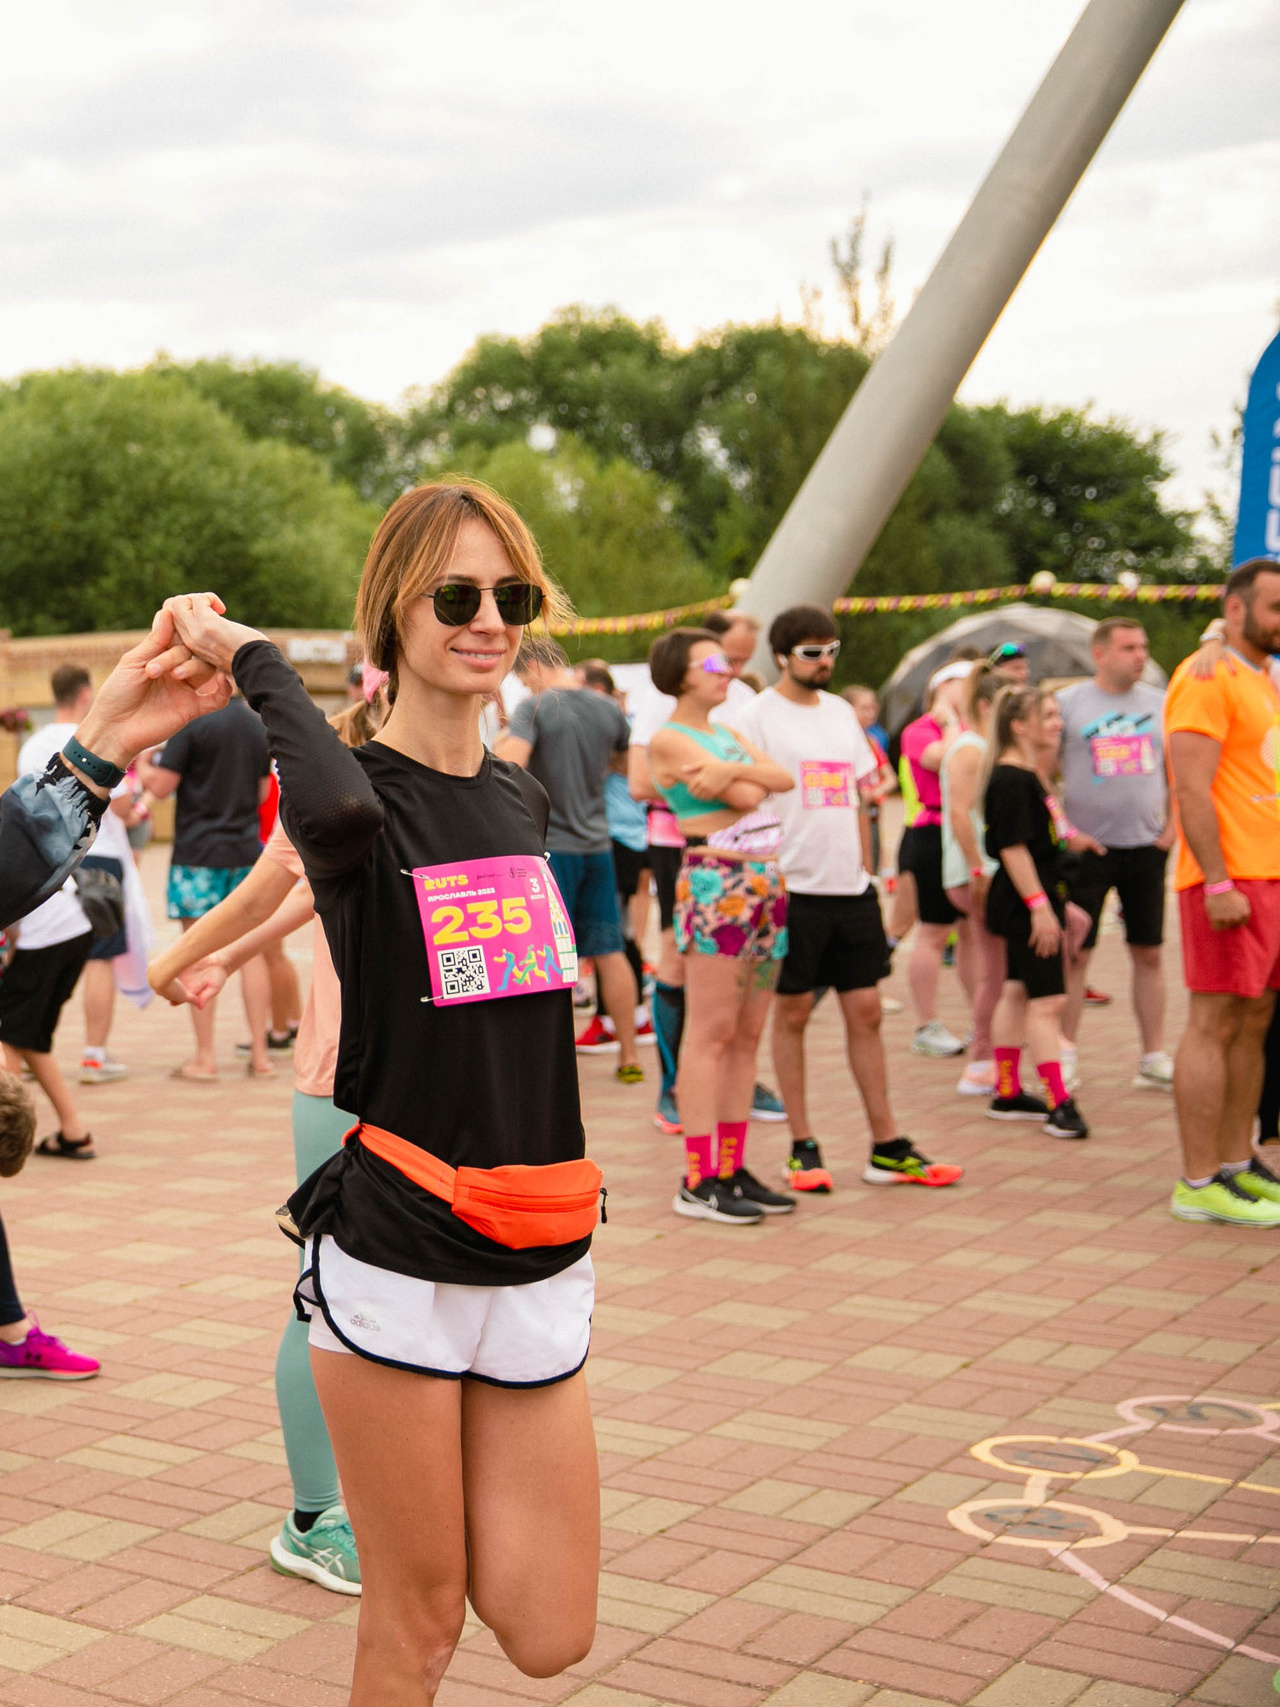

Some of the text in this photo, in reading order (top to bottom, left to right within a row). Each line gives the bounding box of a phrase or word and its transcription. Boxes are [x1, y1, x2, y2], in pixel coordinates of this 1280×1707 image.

[424, 874, 469, 890] RUTS
[529, 878, 541, 893] 3
[427, 887, 496, 902] ЯРОСЛАВЛЬ 2023
[431, 897, 532, 946] 235
